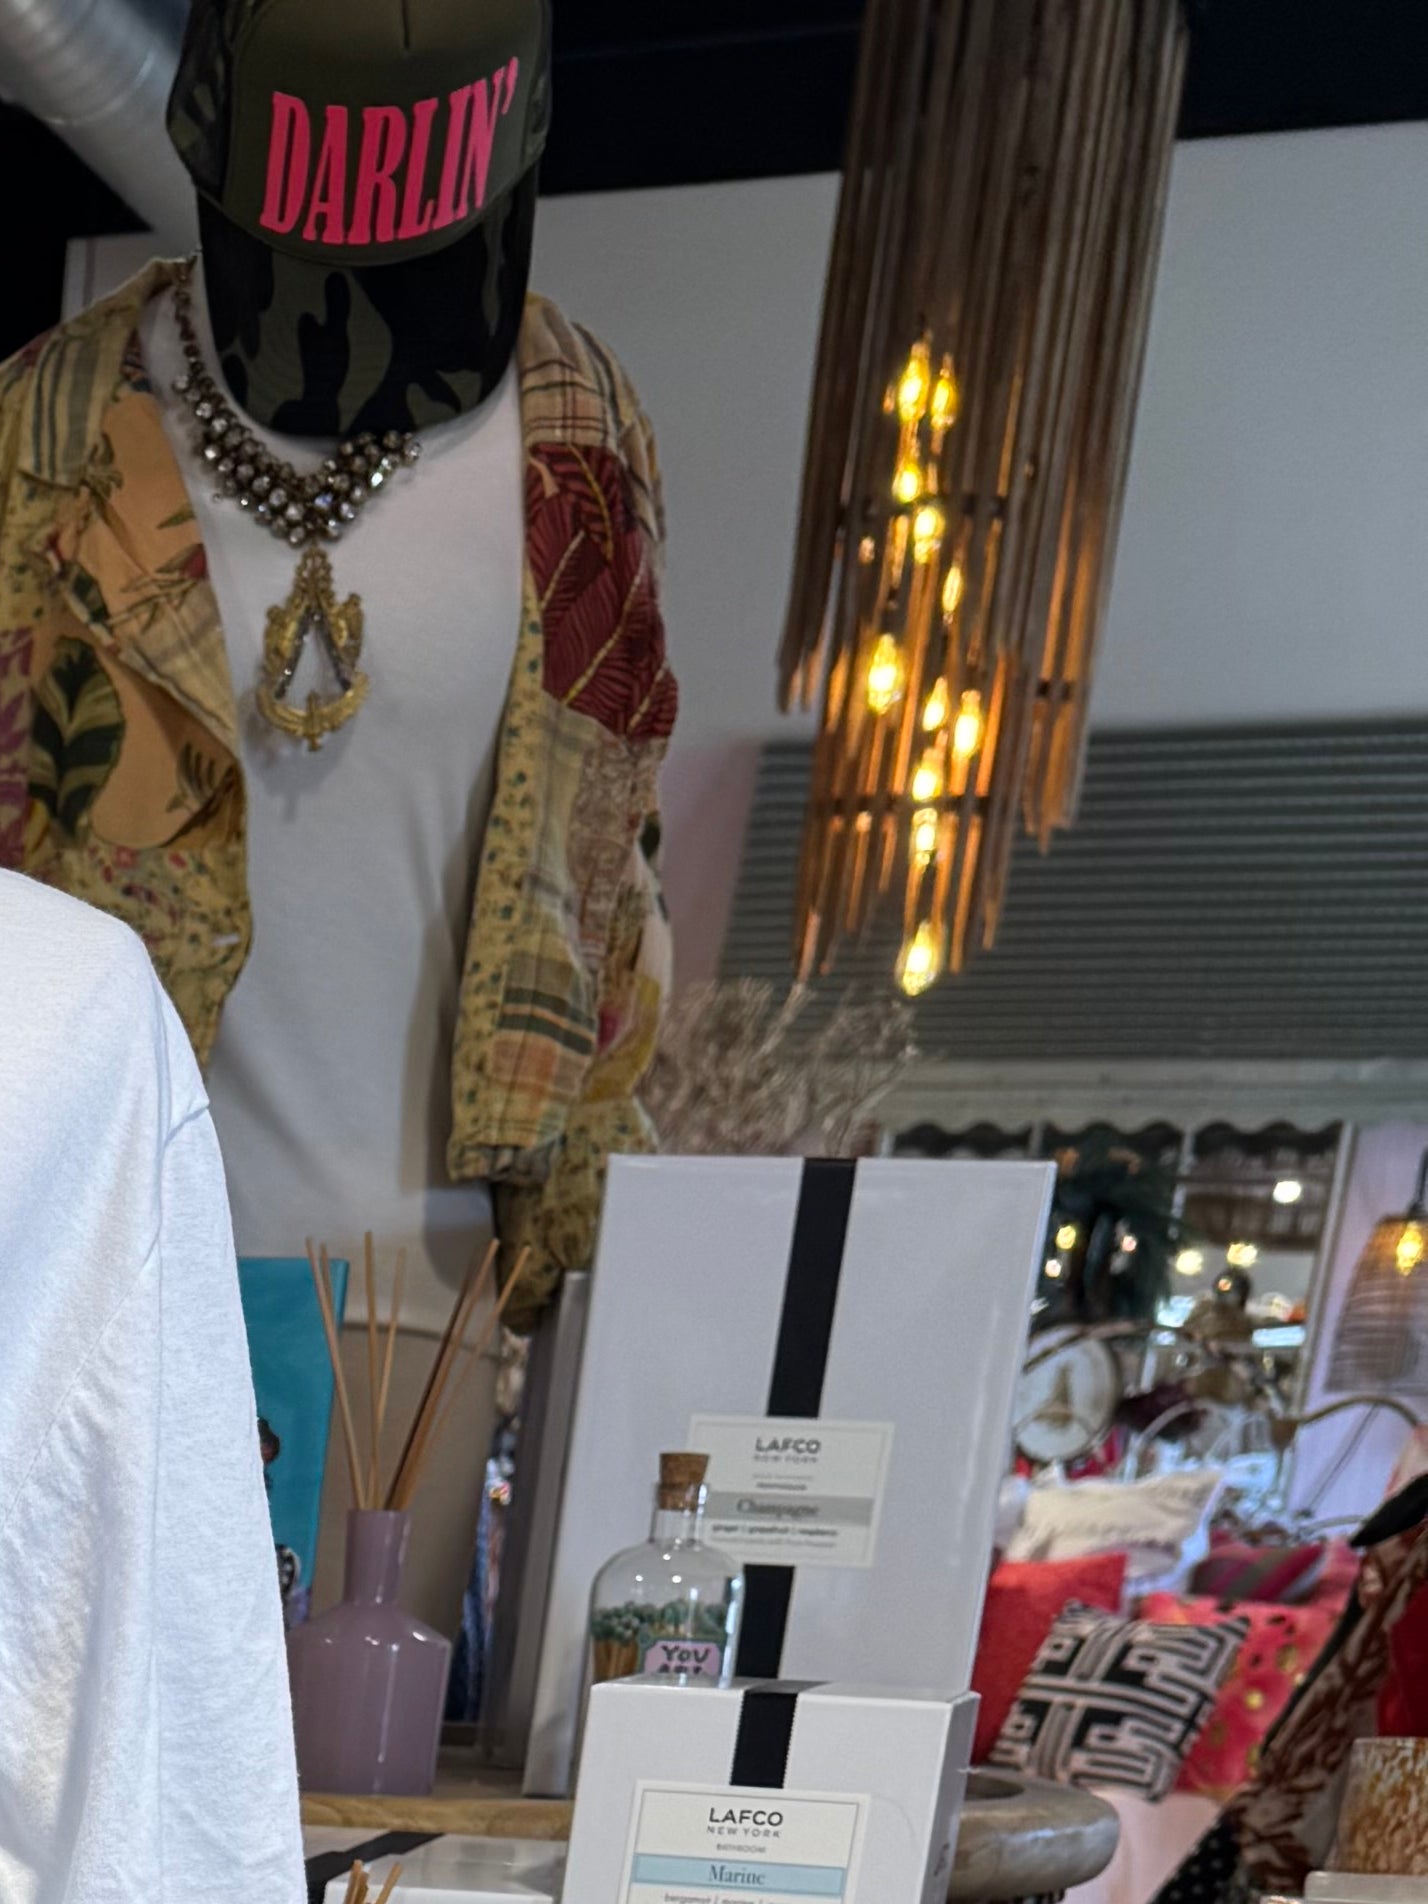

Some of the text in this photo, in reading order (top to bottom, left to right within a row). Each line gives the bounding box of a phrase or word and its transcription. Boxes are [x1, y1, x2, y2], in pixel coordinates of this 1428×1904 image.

[259, 56, 519, 245] DARLIN'
[755, 1437, 821, 1454] LAFCO
[709, 1807, 783, 1827] LAFCO
[707, 1826, 781, 1838] NEW YORK
[709, 1864, 766, 1886] Marine
